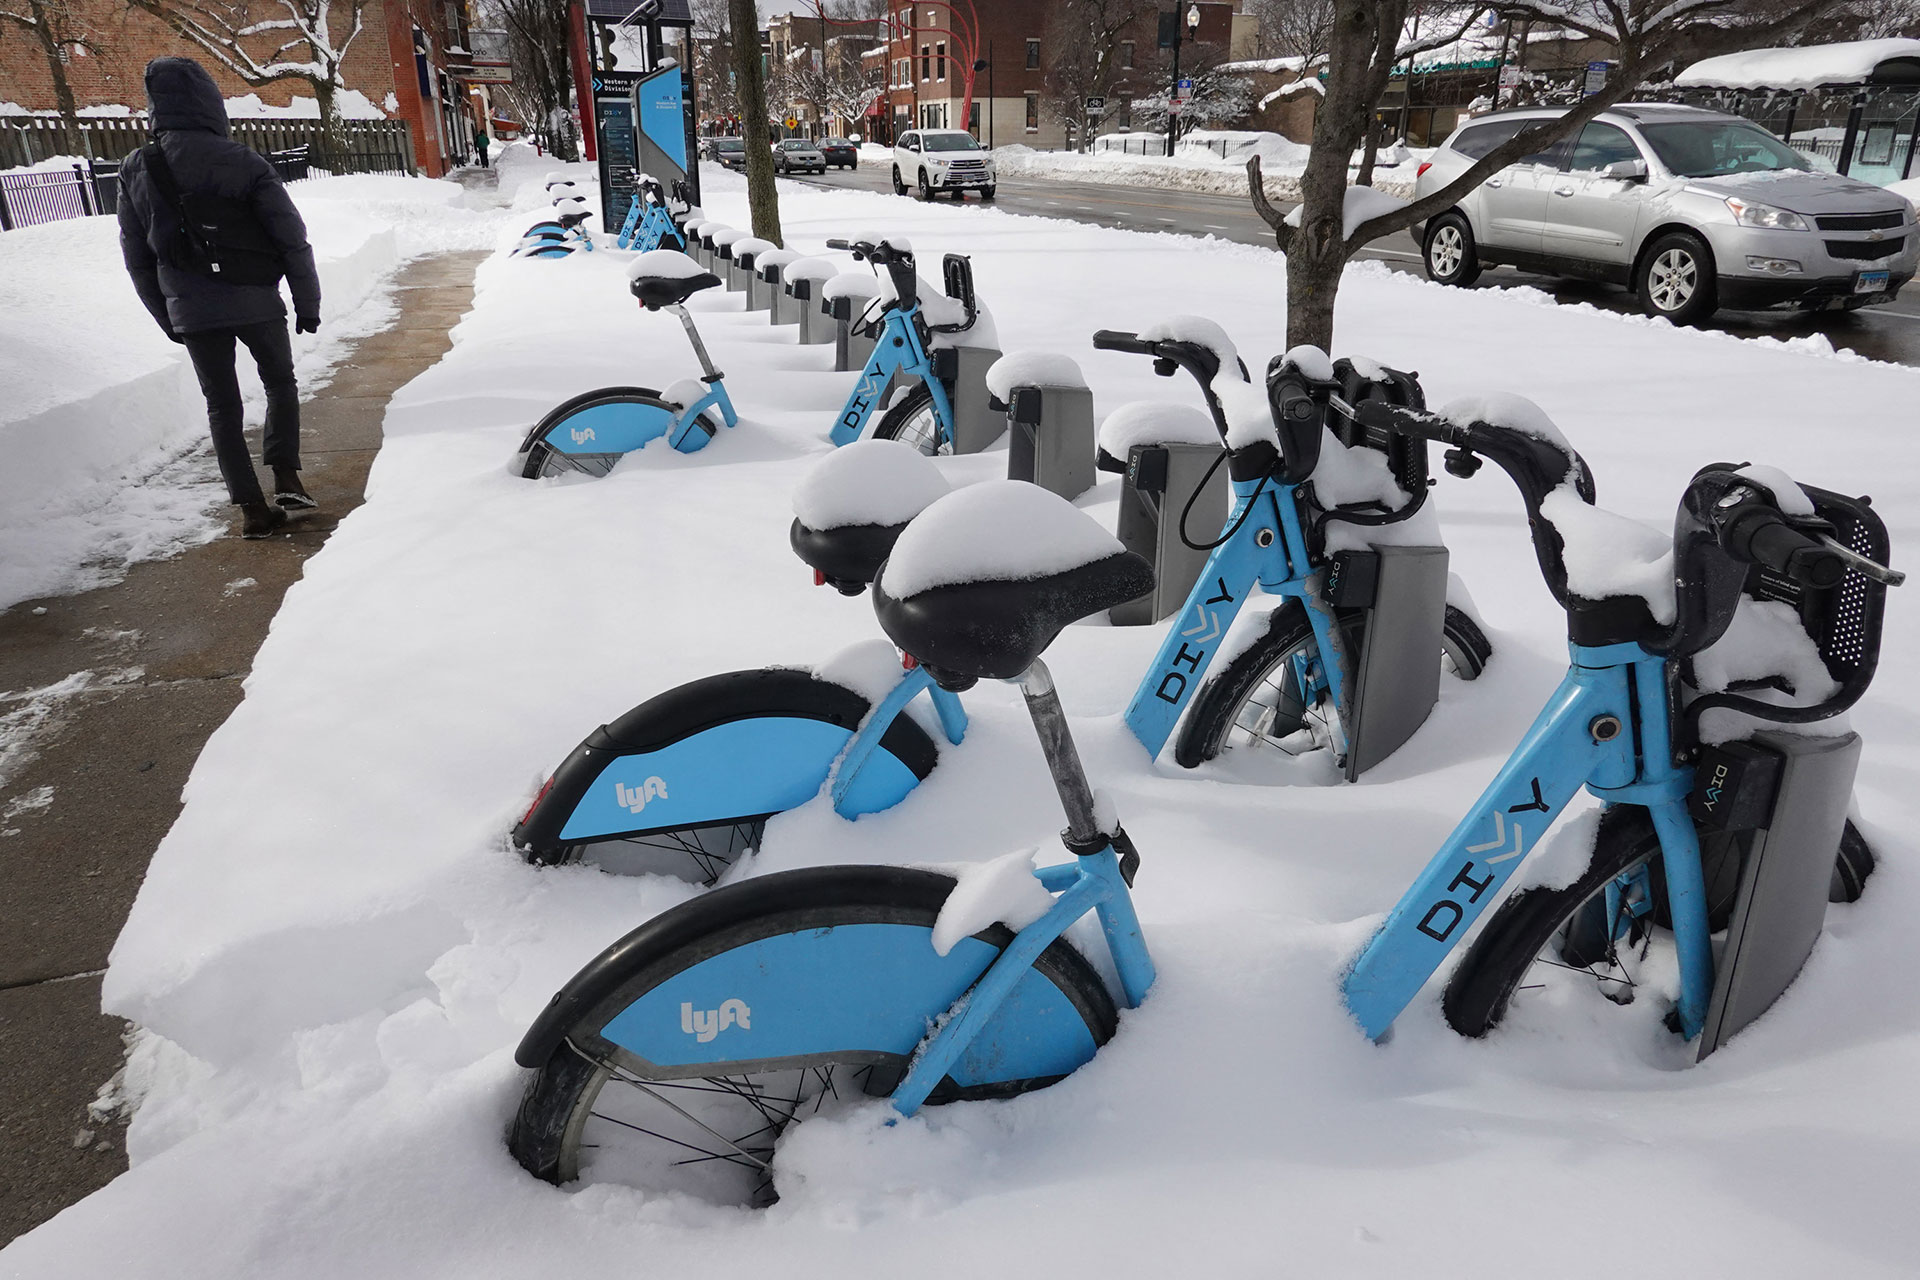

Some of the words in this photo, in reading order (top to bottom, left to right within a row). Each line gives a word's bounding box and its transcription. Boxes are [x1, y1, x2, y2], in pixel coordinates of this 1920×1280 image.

[843, 362, 885, 430] DIVVY
[571, 427, 596, 446] lyft
[1327, 561, 1341, 596] DIVVY
[1155, 576, 1235, 705] DIVVY
[615, 775, 668, 814] lyft
[1703, 764, 1728, 812] DIVVY
[1416, 776, 1550, 943] DIVVY
[680, 998, 751, 1043] lyft
